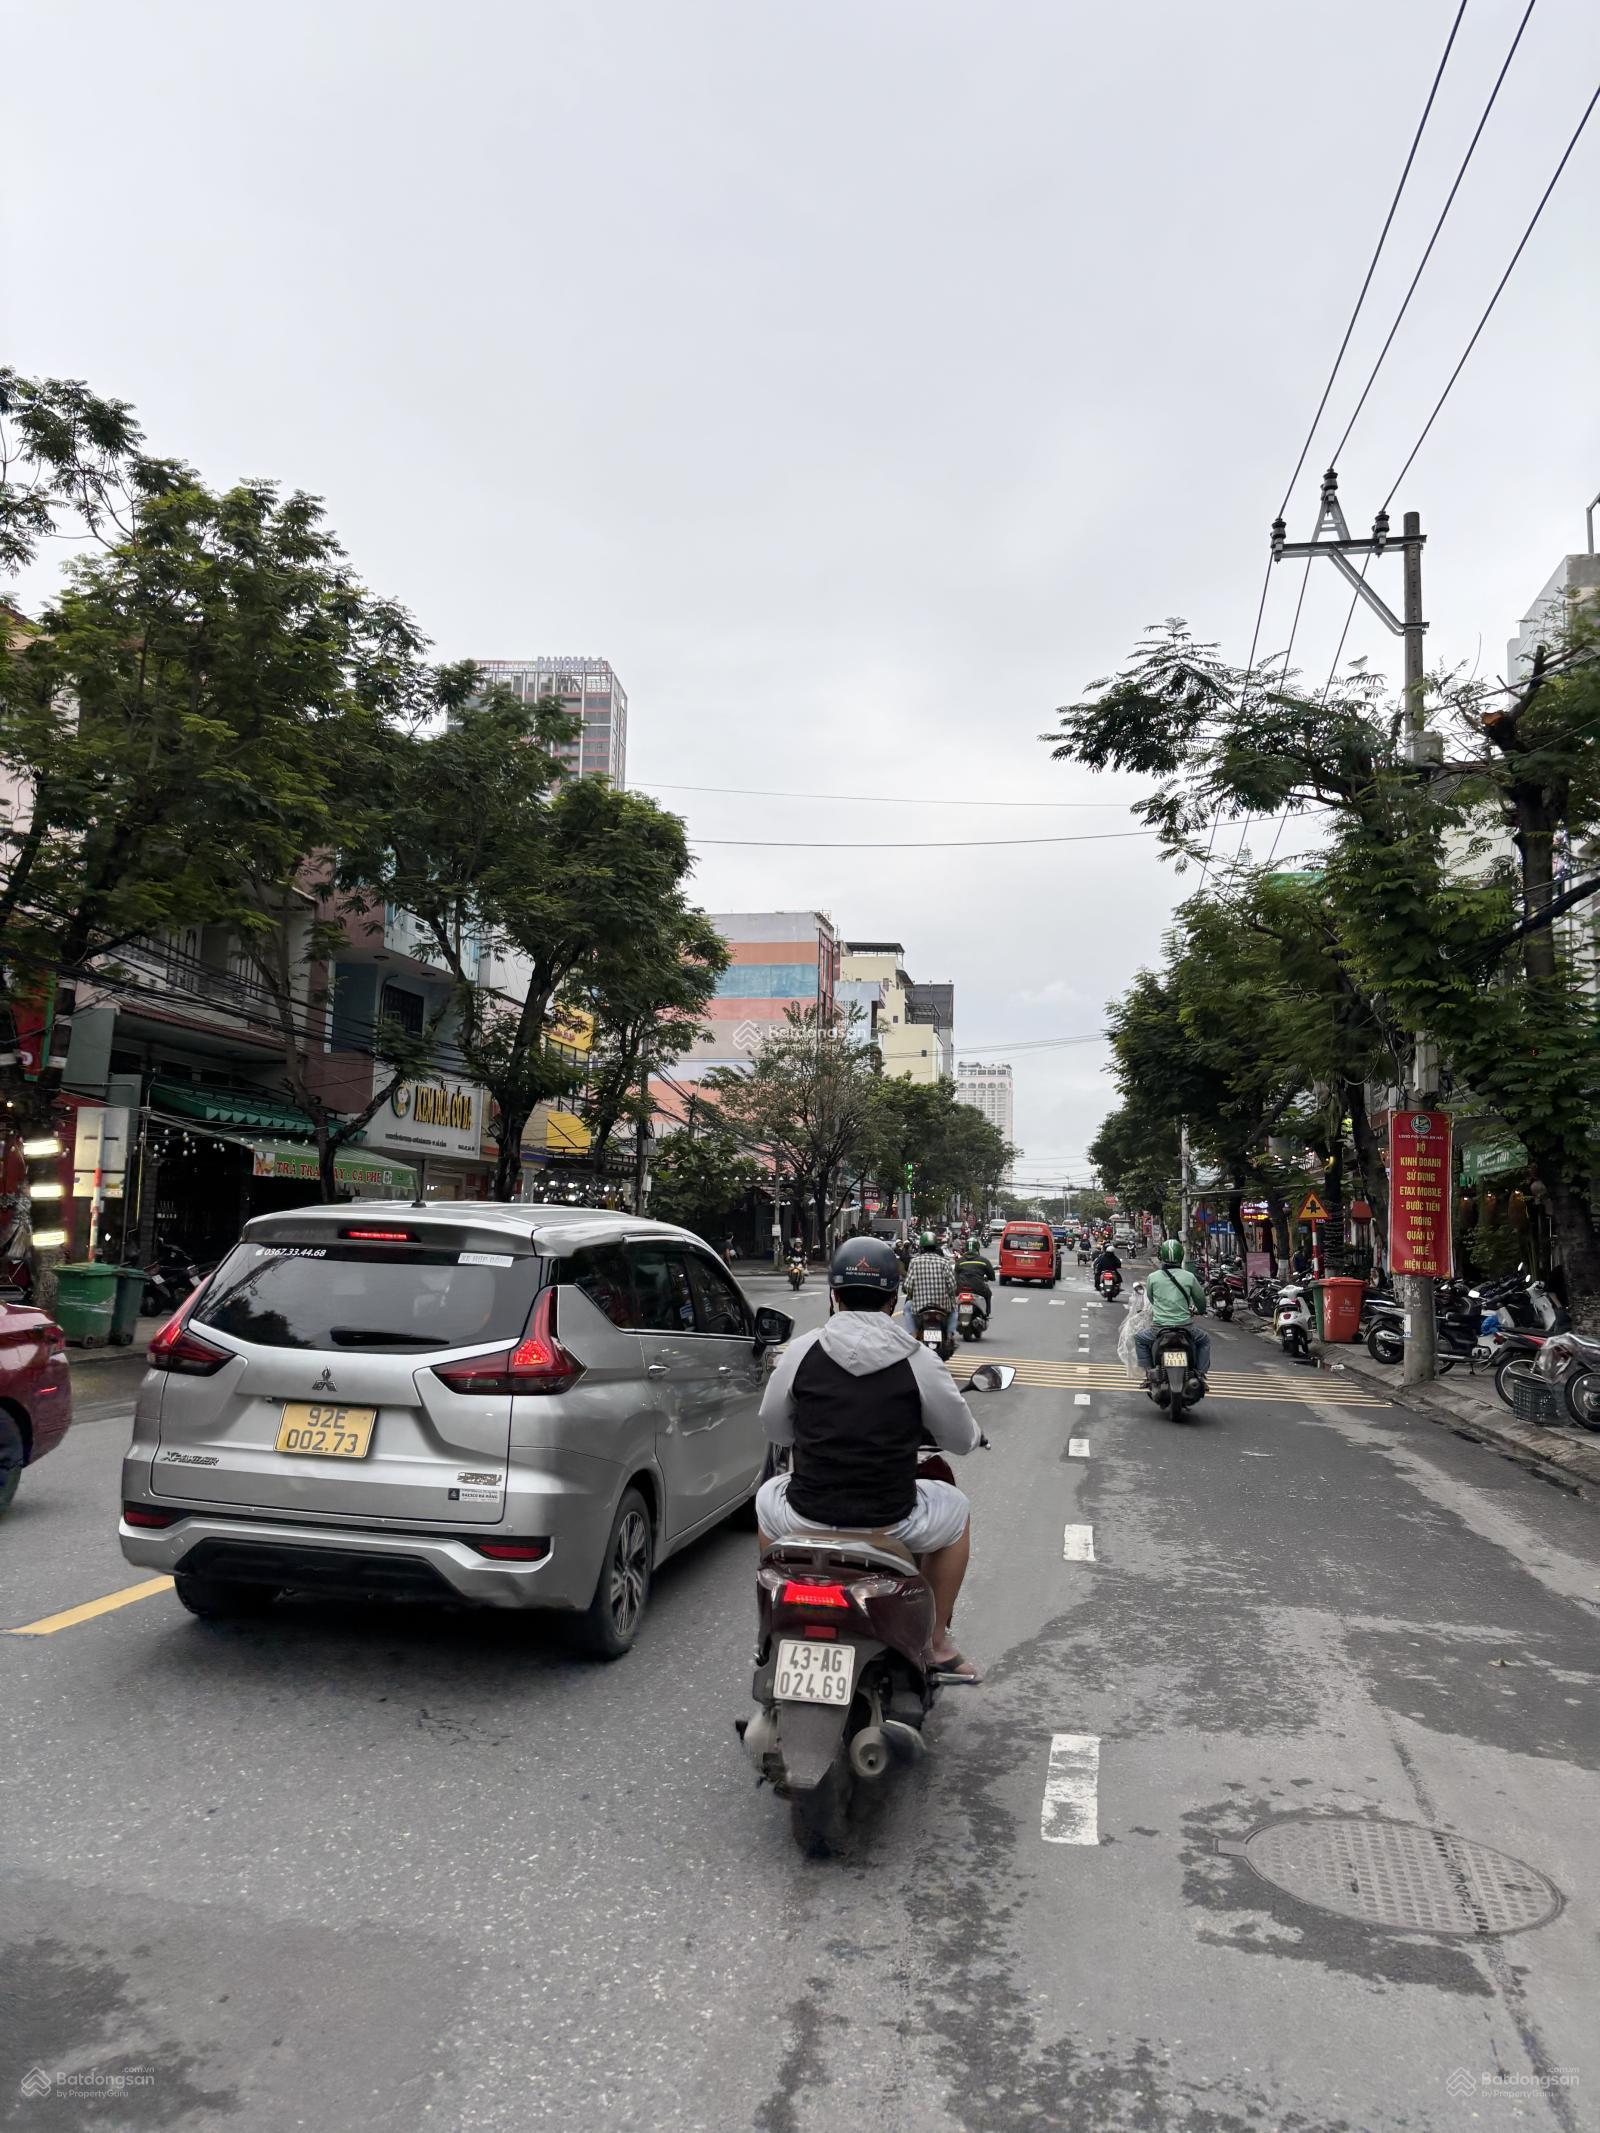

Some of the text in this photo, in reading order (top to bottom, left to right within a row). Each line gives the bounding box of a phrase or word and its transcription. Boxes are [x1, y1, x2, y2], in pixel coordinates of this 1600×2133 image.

[1400, 1157, 1441, 1167] KINH DOANH
[1406, 1169, 1416, 1181] SỬ
[1400, 1186, 1441, 1197] ETAX MOBILE
[1410, 1216, 1432, 1226] TRONG
[264, 1247, 327, 1257] 0367.33.44.68
[307, 1406, 348, 1429] 92E
[286, 1428, 358, 1454] 002.73
[789, 1645, 843, 1673] 43-AG
[780, 1671, 847, 1700] 024.69
